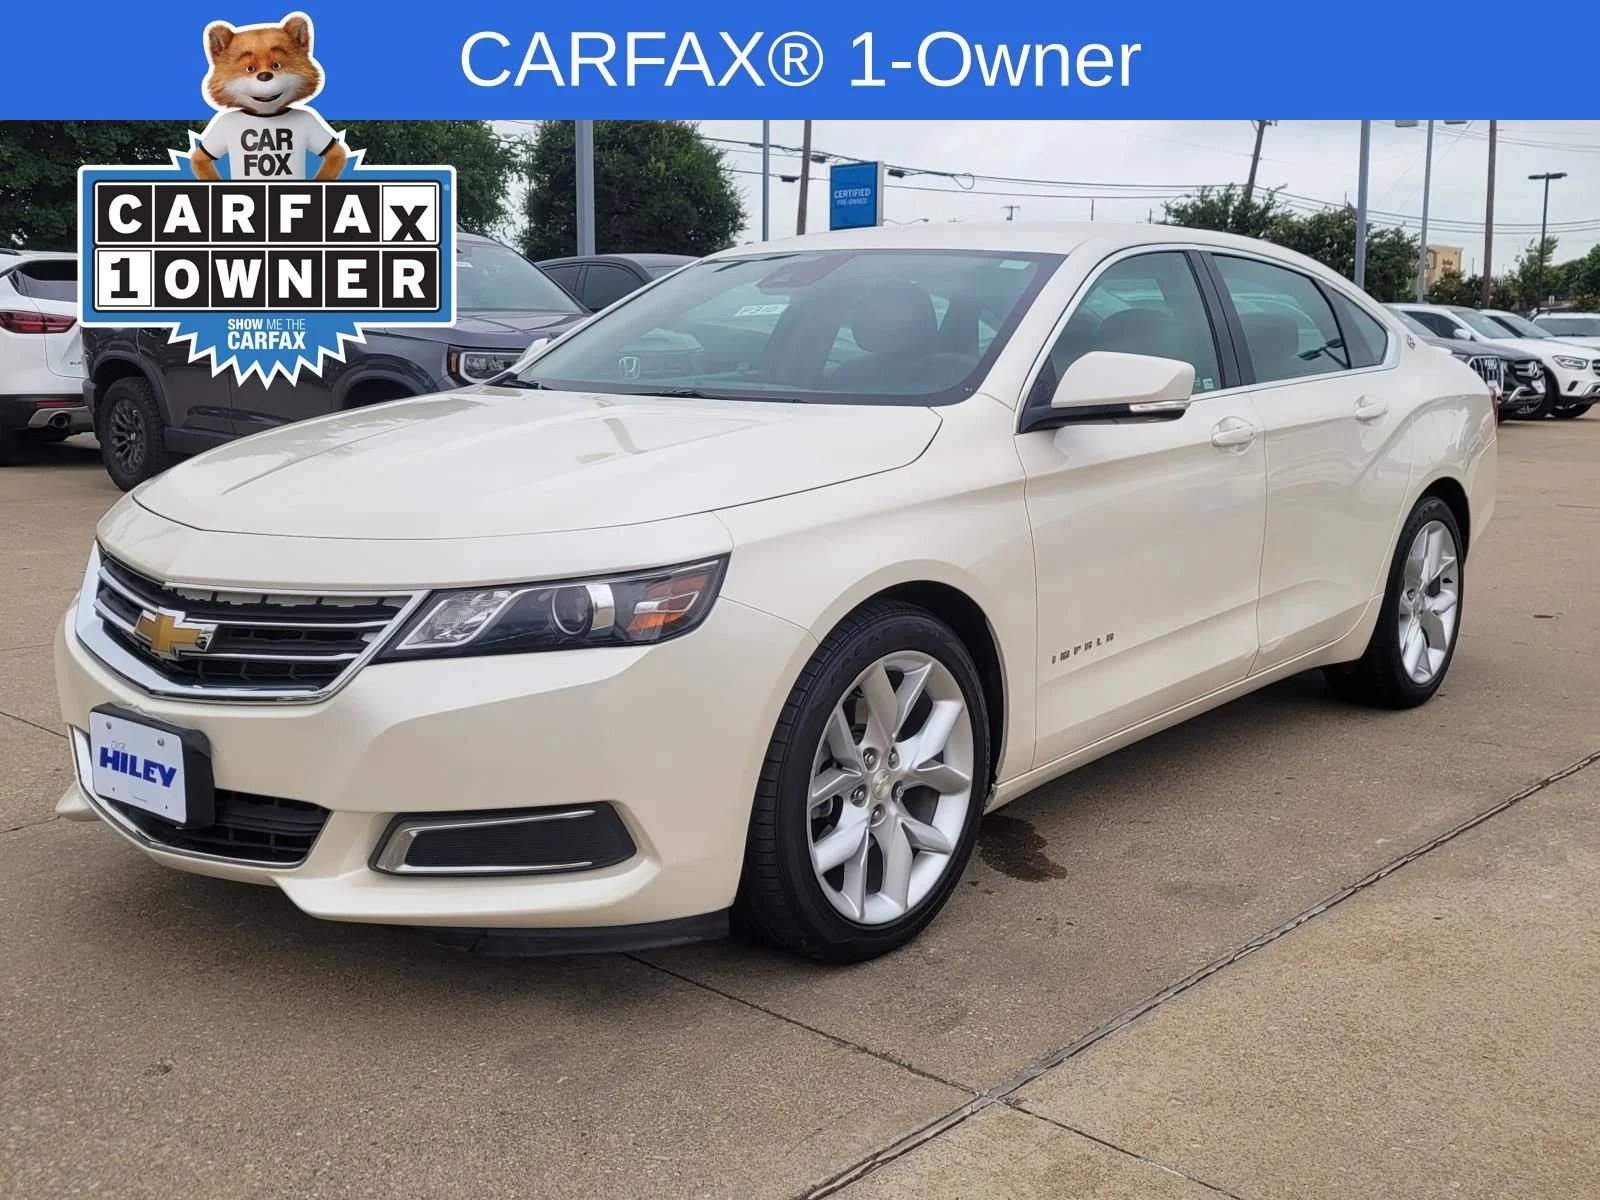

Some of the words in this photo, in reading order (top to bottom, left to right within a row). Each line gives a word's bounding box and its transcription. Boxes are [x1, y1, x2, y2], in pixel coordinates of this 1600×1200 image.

[833, 188, 871, 199] CERTIFIED
[1051, 632, 1115, 665] IMPALA
[99, 746, 177, 788] HILEY
